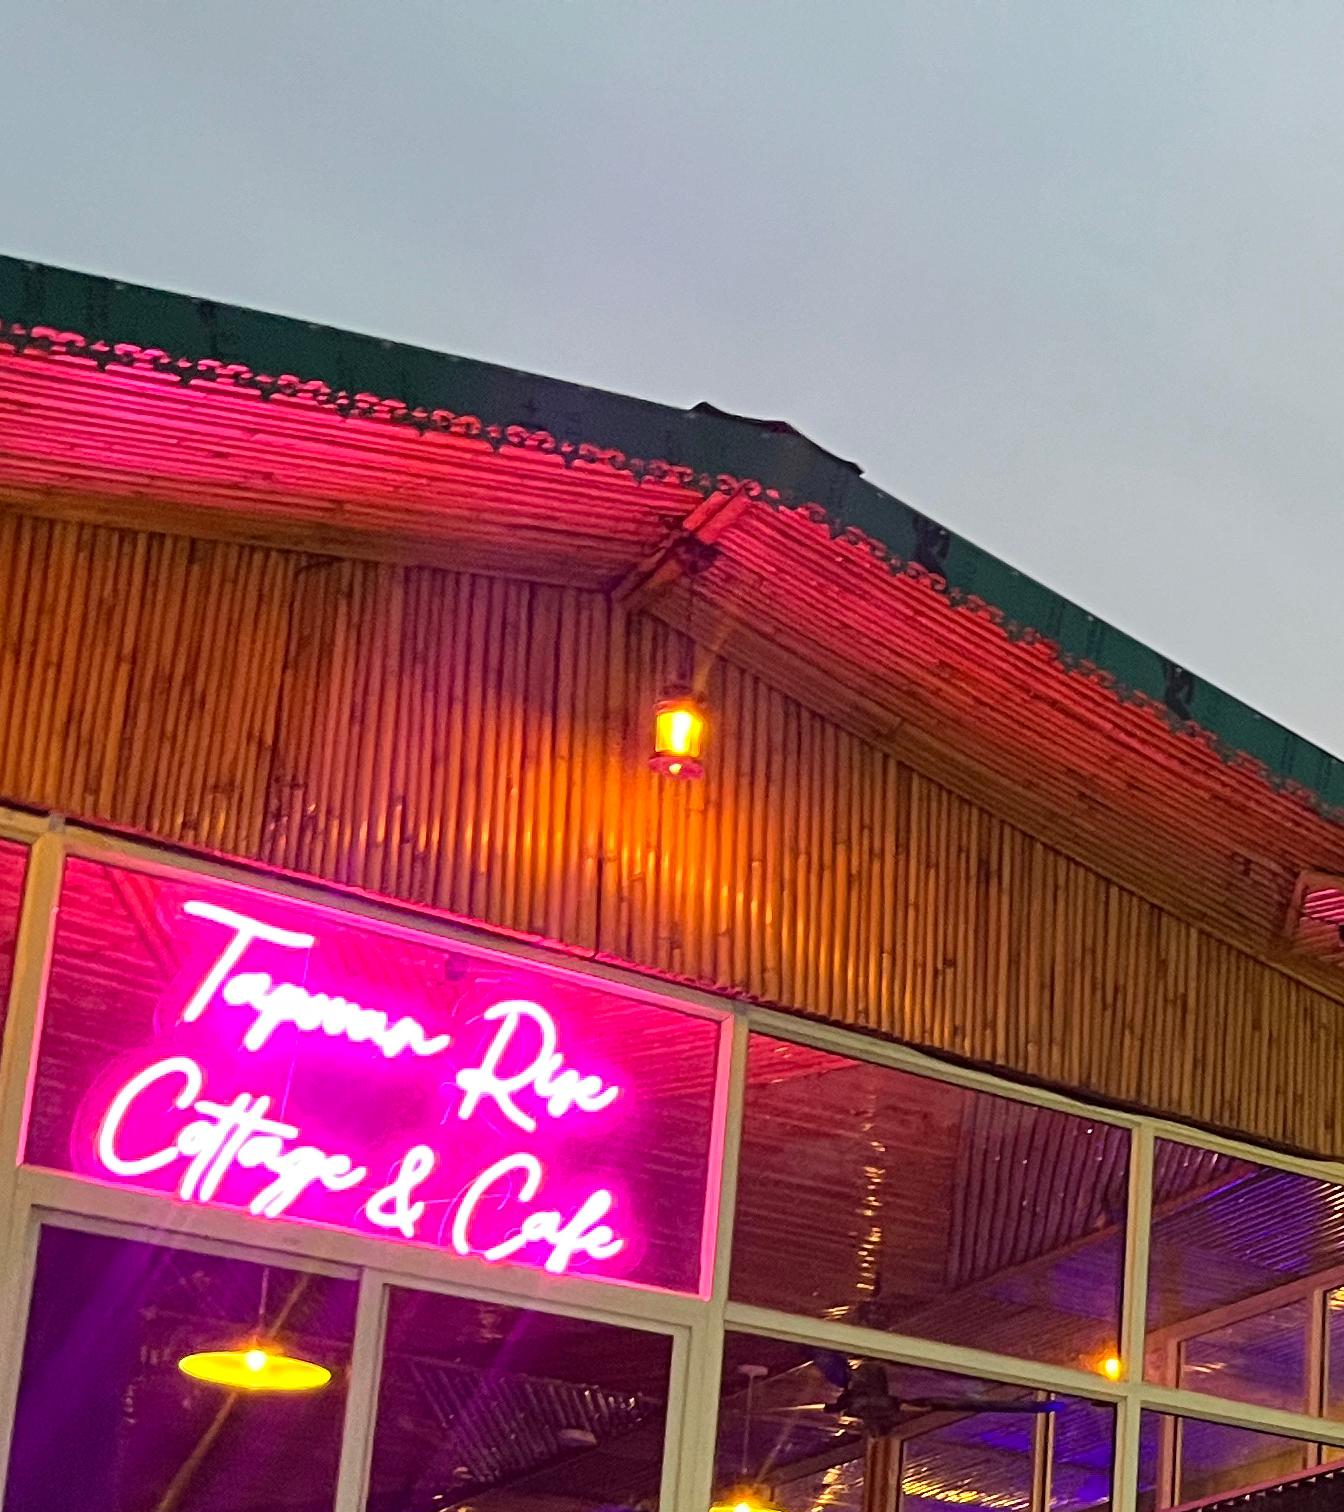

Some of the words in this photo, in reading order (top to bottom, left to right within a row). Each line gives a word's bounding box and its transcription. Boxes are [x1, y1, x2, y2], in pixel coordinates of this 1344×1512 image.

[456, 999, 620, 1132] Rise
[98, 1056, 368, 1218] Cottage
[366, 1144, 436, 1238] &
[452, 1152, 625, 1273] Cafe
